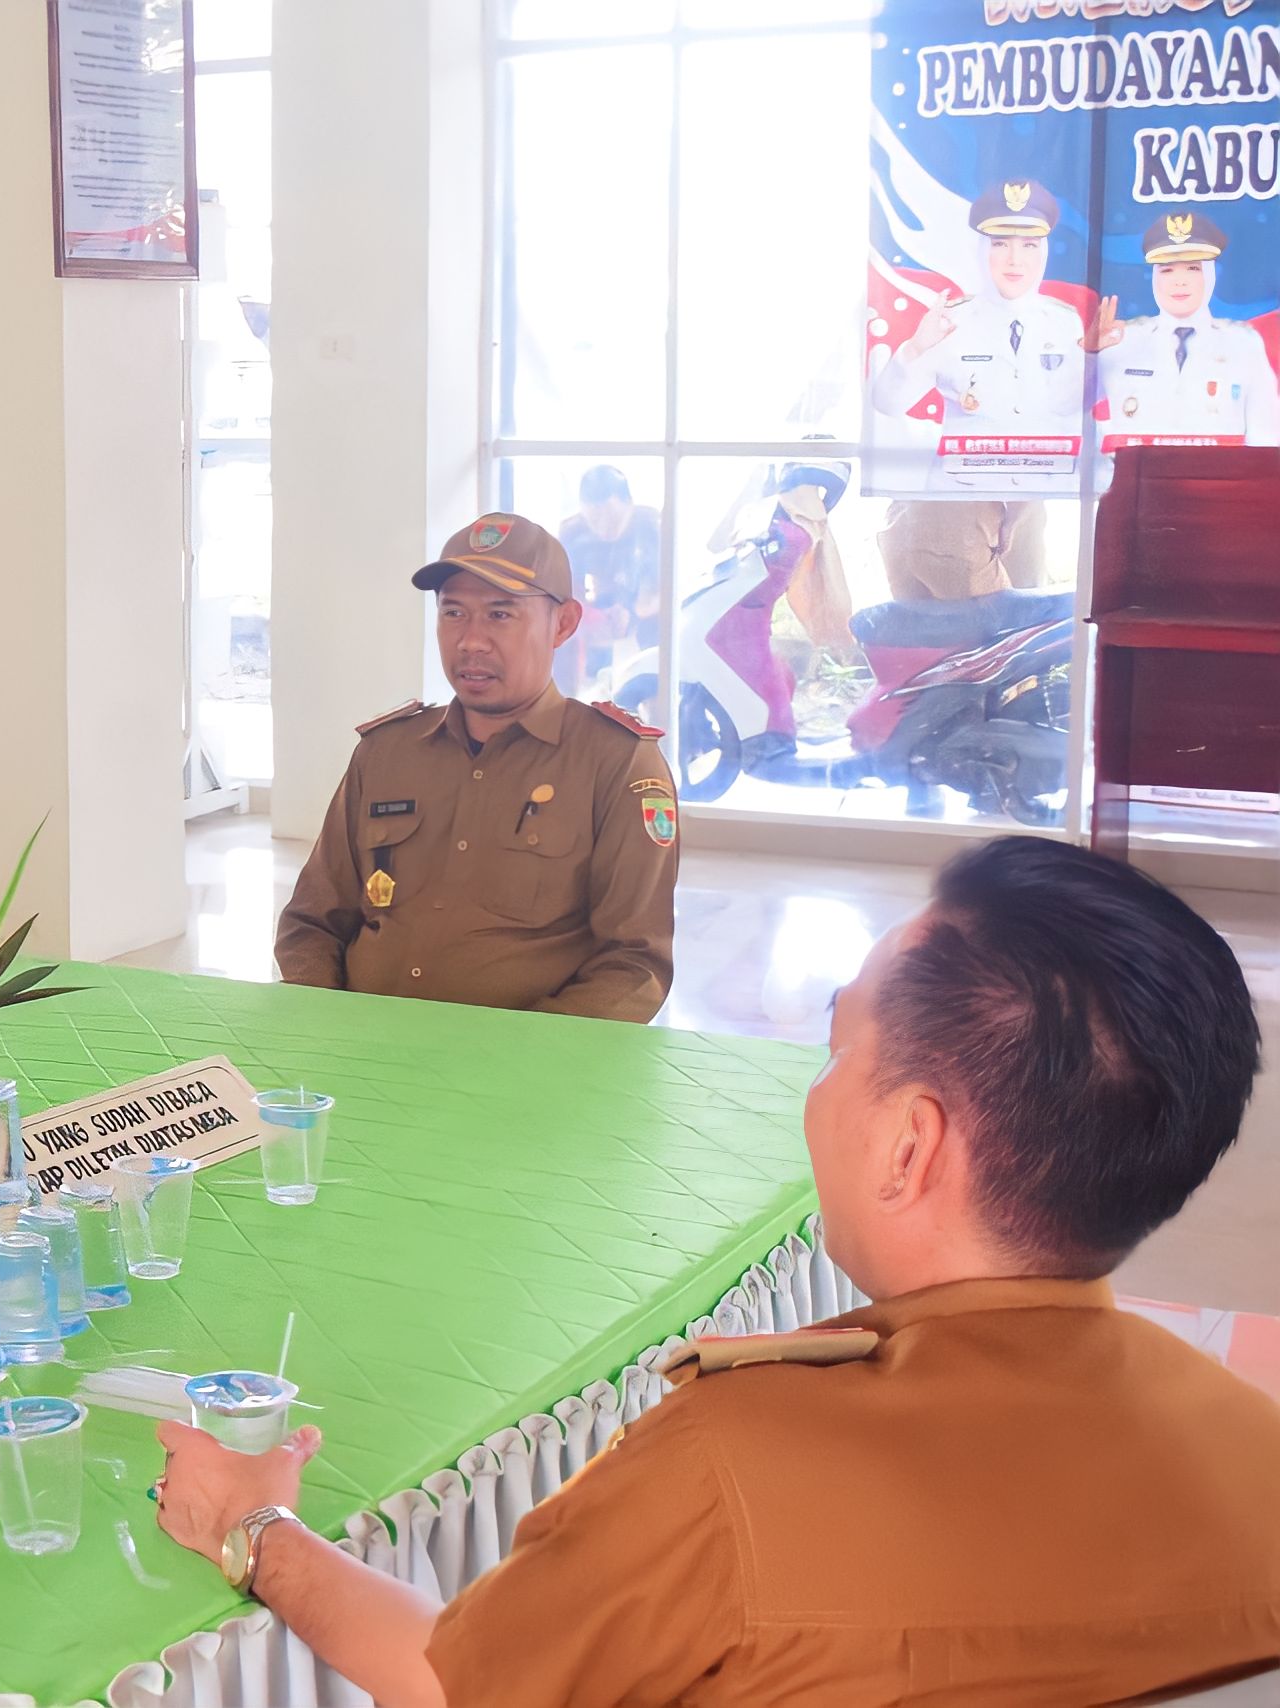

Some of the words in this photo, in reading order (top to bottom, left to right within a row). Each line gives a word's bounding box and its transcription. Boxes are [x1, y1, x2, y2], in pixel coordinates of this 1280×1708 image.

[920, 29, 1280, 114] PEMBUDAYAAN
[1136, 127, 1280, 199] KABU
[33, 1121, 89, 1155] YANG
[90, 1100, 152, 1137] SUDAH
[146, 1080, 219, 1117] DIBACA
